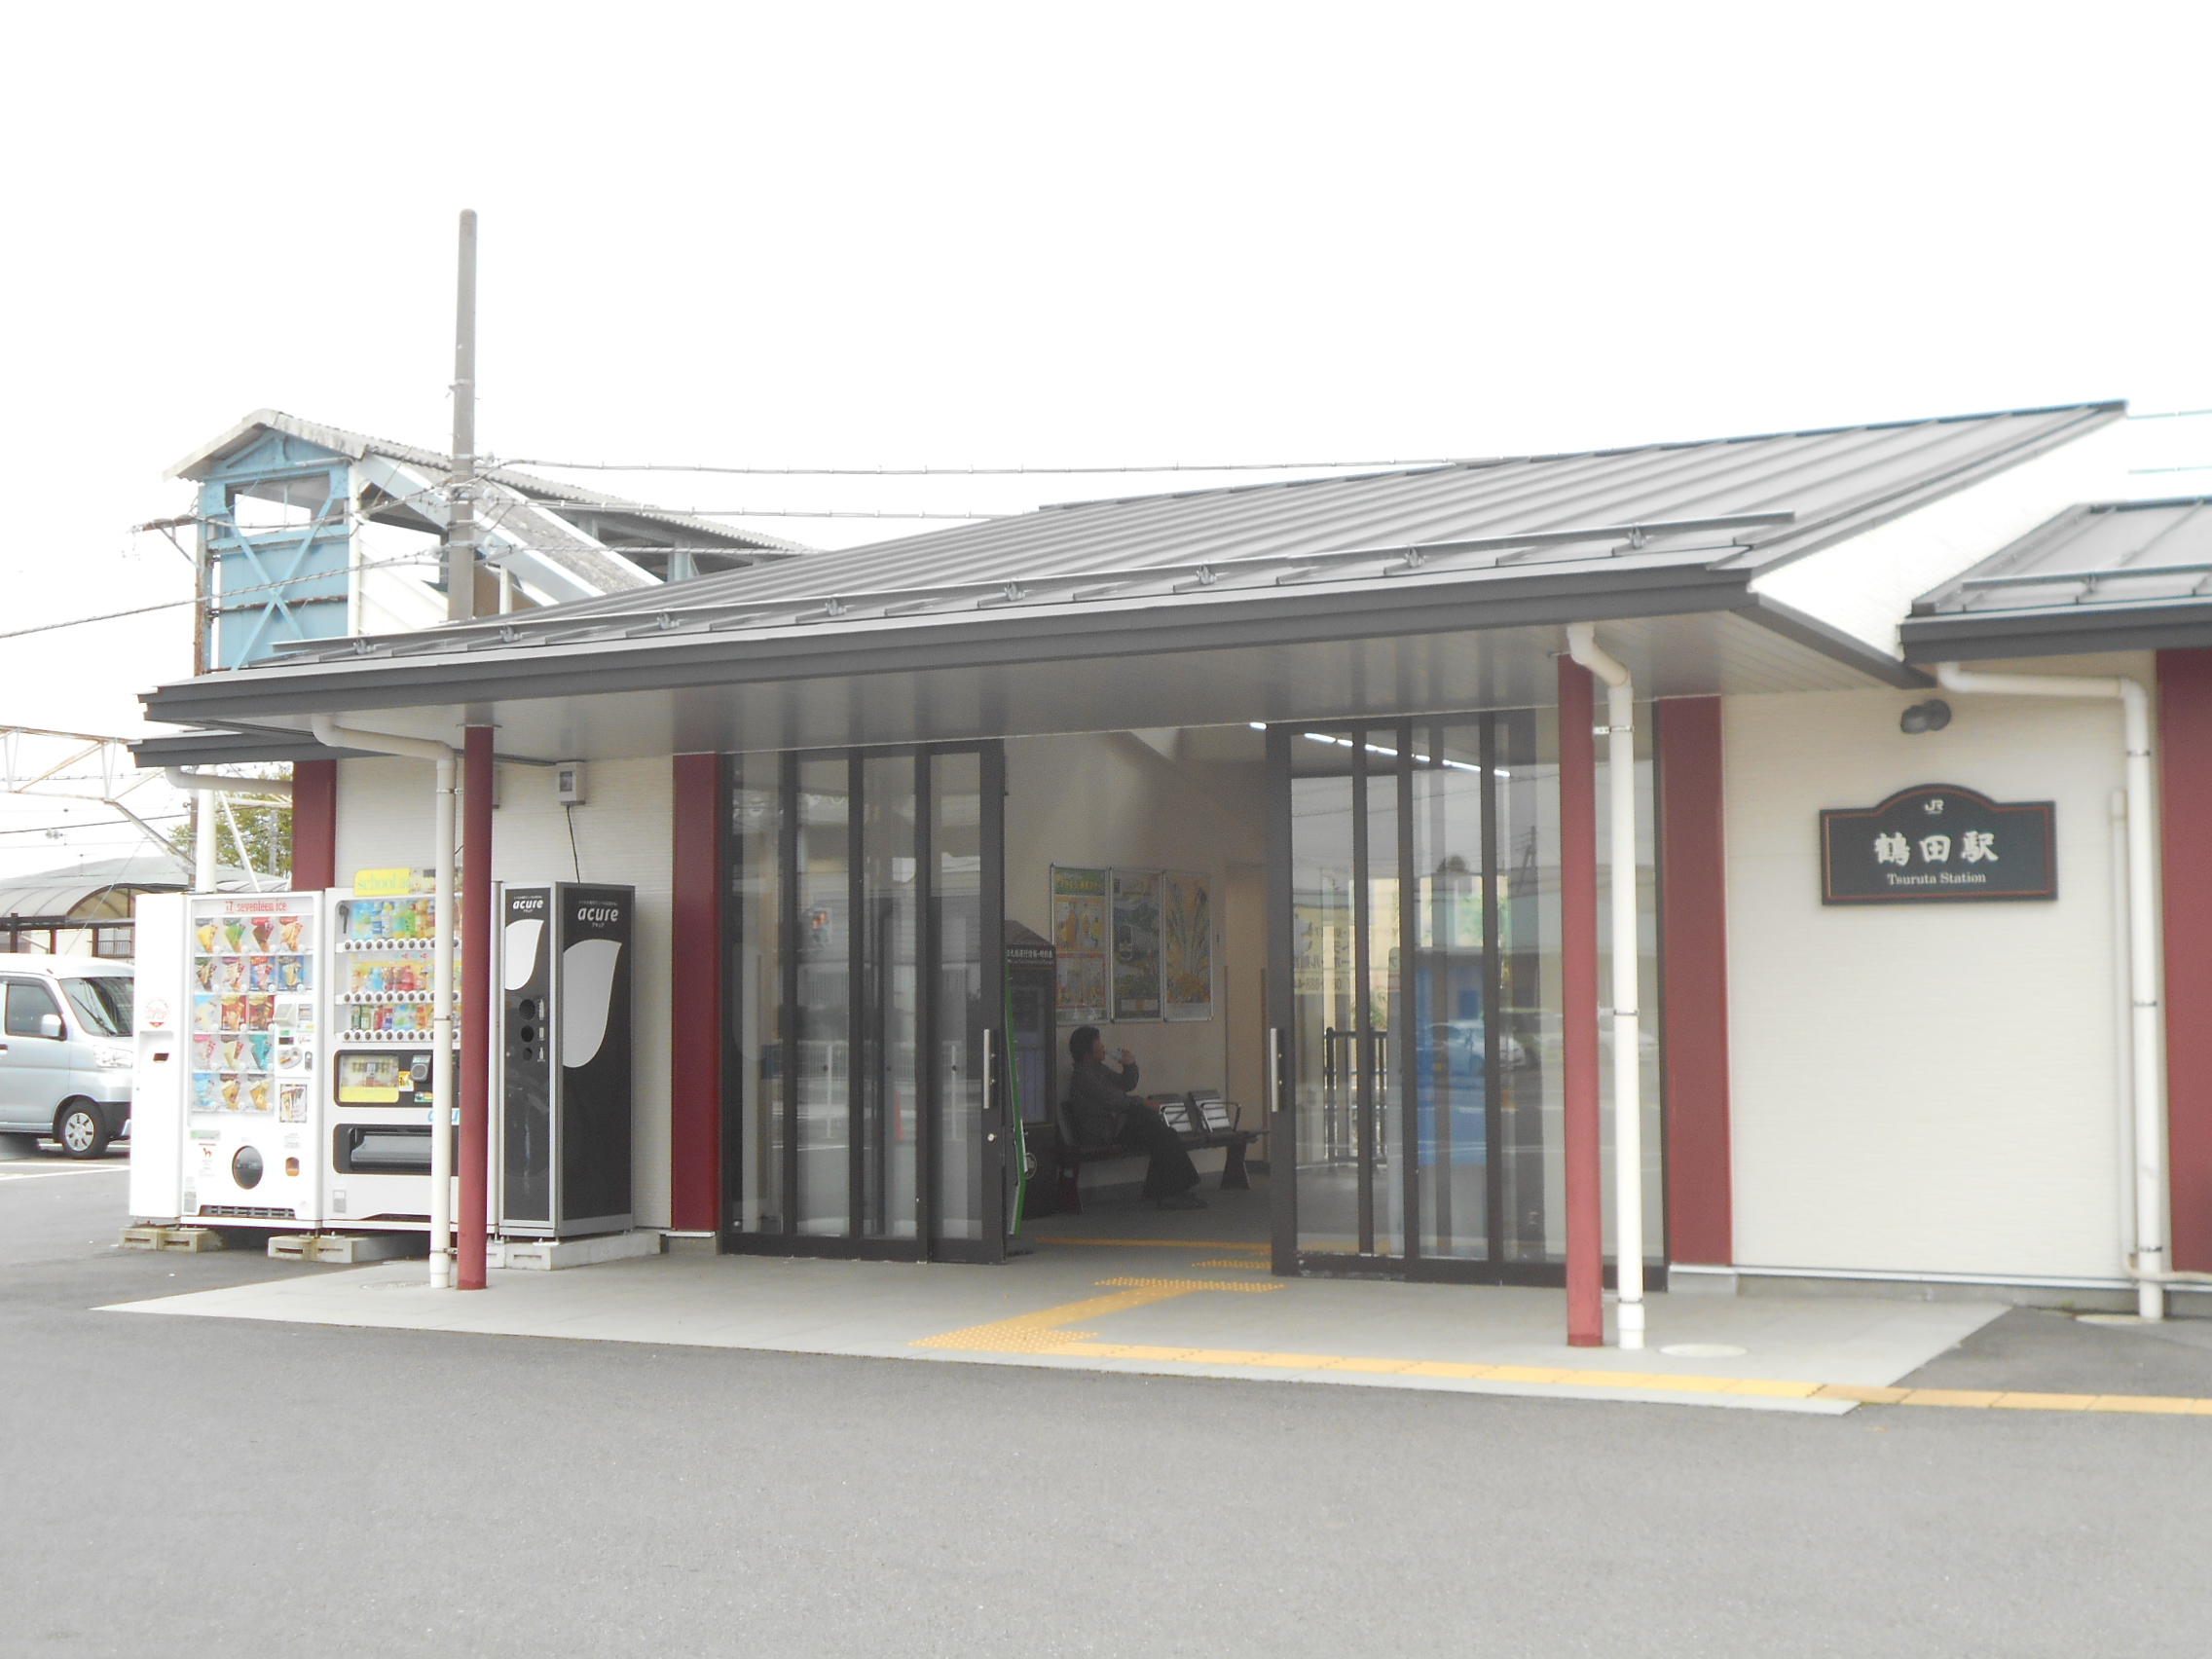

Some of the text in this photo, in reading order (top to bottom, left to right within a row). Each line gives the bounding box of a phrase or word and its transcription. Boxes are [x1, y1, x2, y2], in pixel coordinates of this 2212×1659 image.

[1925, 799, 1944, 811] JR
[1874, 830, 1999, 866] 鶴田駅
[1887, 871, 1986, 885] Tsuruta Station
[237, 901, 274, 912] seventeen
[276, 899, 287, 911] ice
[513, 900, 543, 909] acure
[577, 906, 619, 922] acure
